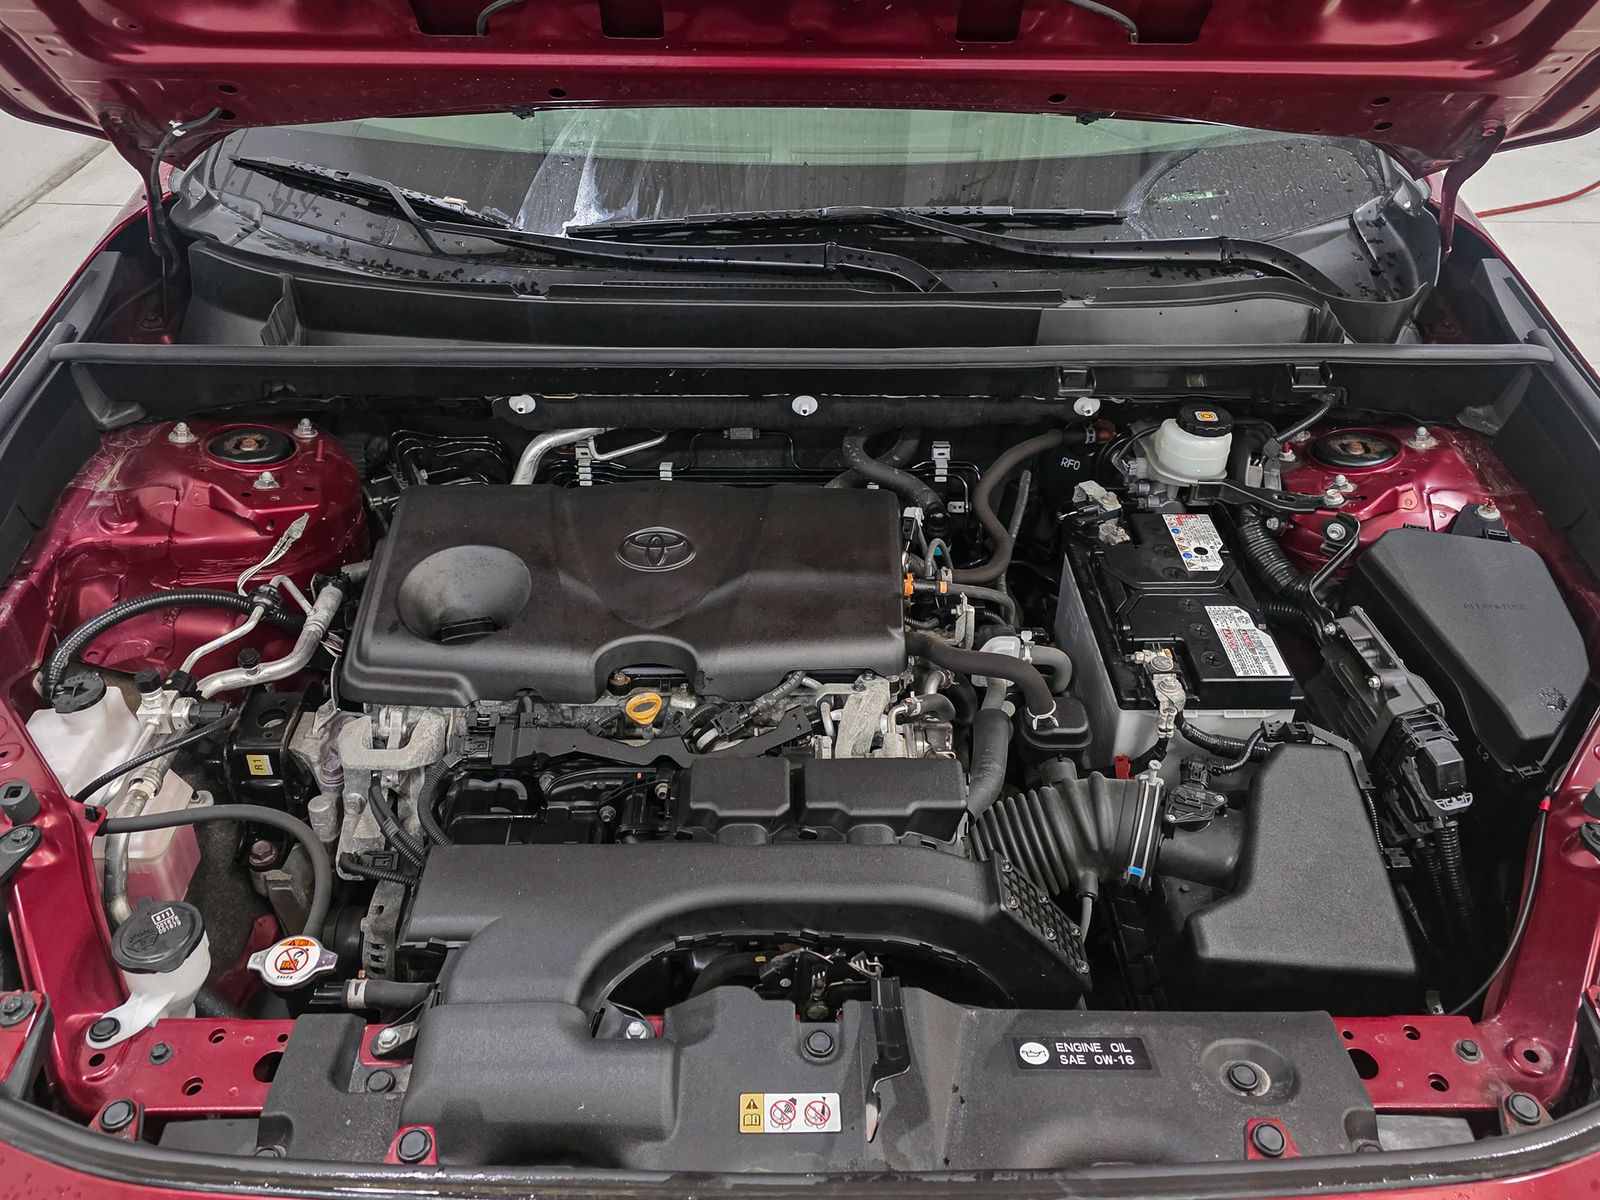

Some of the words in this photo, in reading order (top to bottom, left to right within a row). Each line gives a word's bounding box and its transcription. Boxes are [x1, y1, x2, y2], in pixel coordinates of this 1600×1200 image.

[1055, 1042, 1103, 1053] ENGINE
[1109, 1042, 1132, 1053] OIL
[1060, 1054, 1087, 1065] SAE
